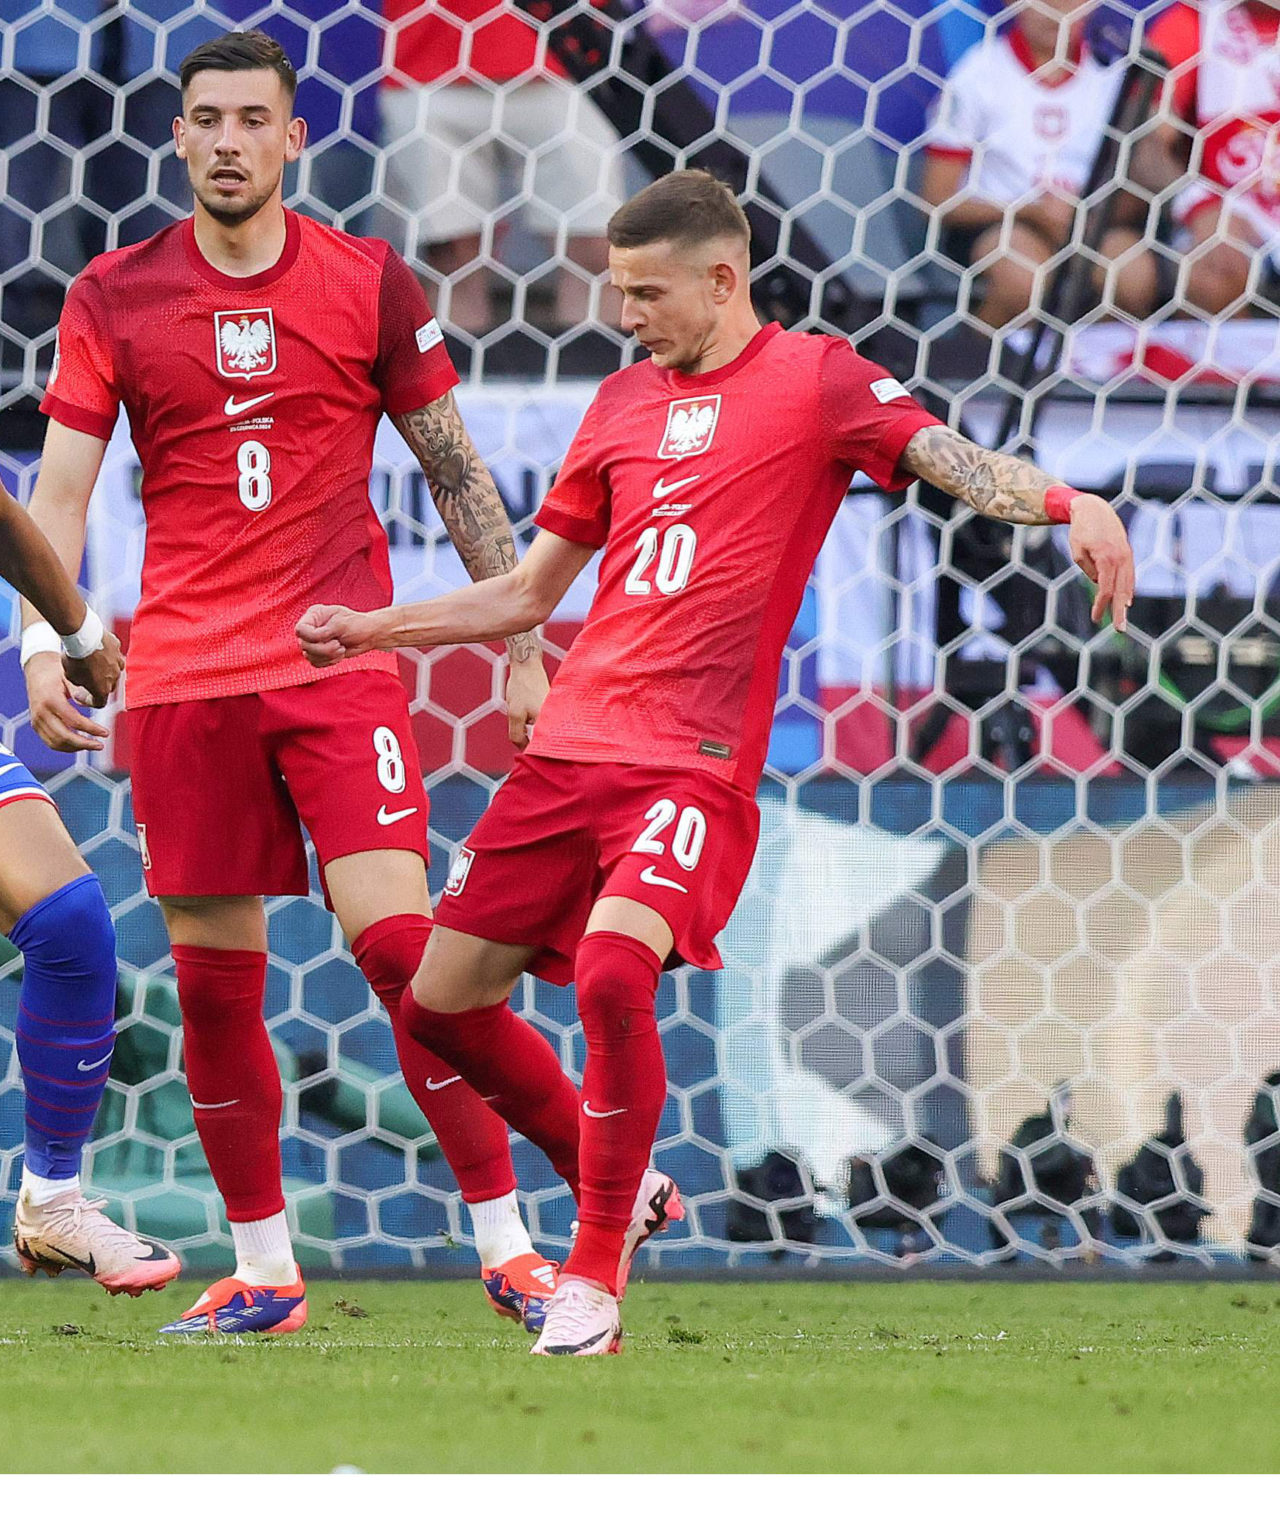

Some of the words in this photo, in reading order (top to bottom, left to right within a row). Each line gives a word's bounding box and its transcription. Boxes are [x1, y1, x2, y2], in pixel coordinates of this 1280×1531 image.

[238, 440, 271, 511] 8
[624, 523, 697, 596] 20
[373, 726, 406, 794] 8
[631, 798, 707, 871] 20
